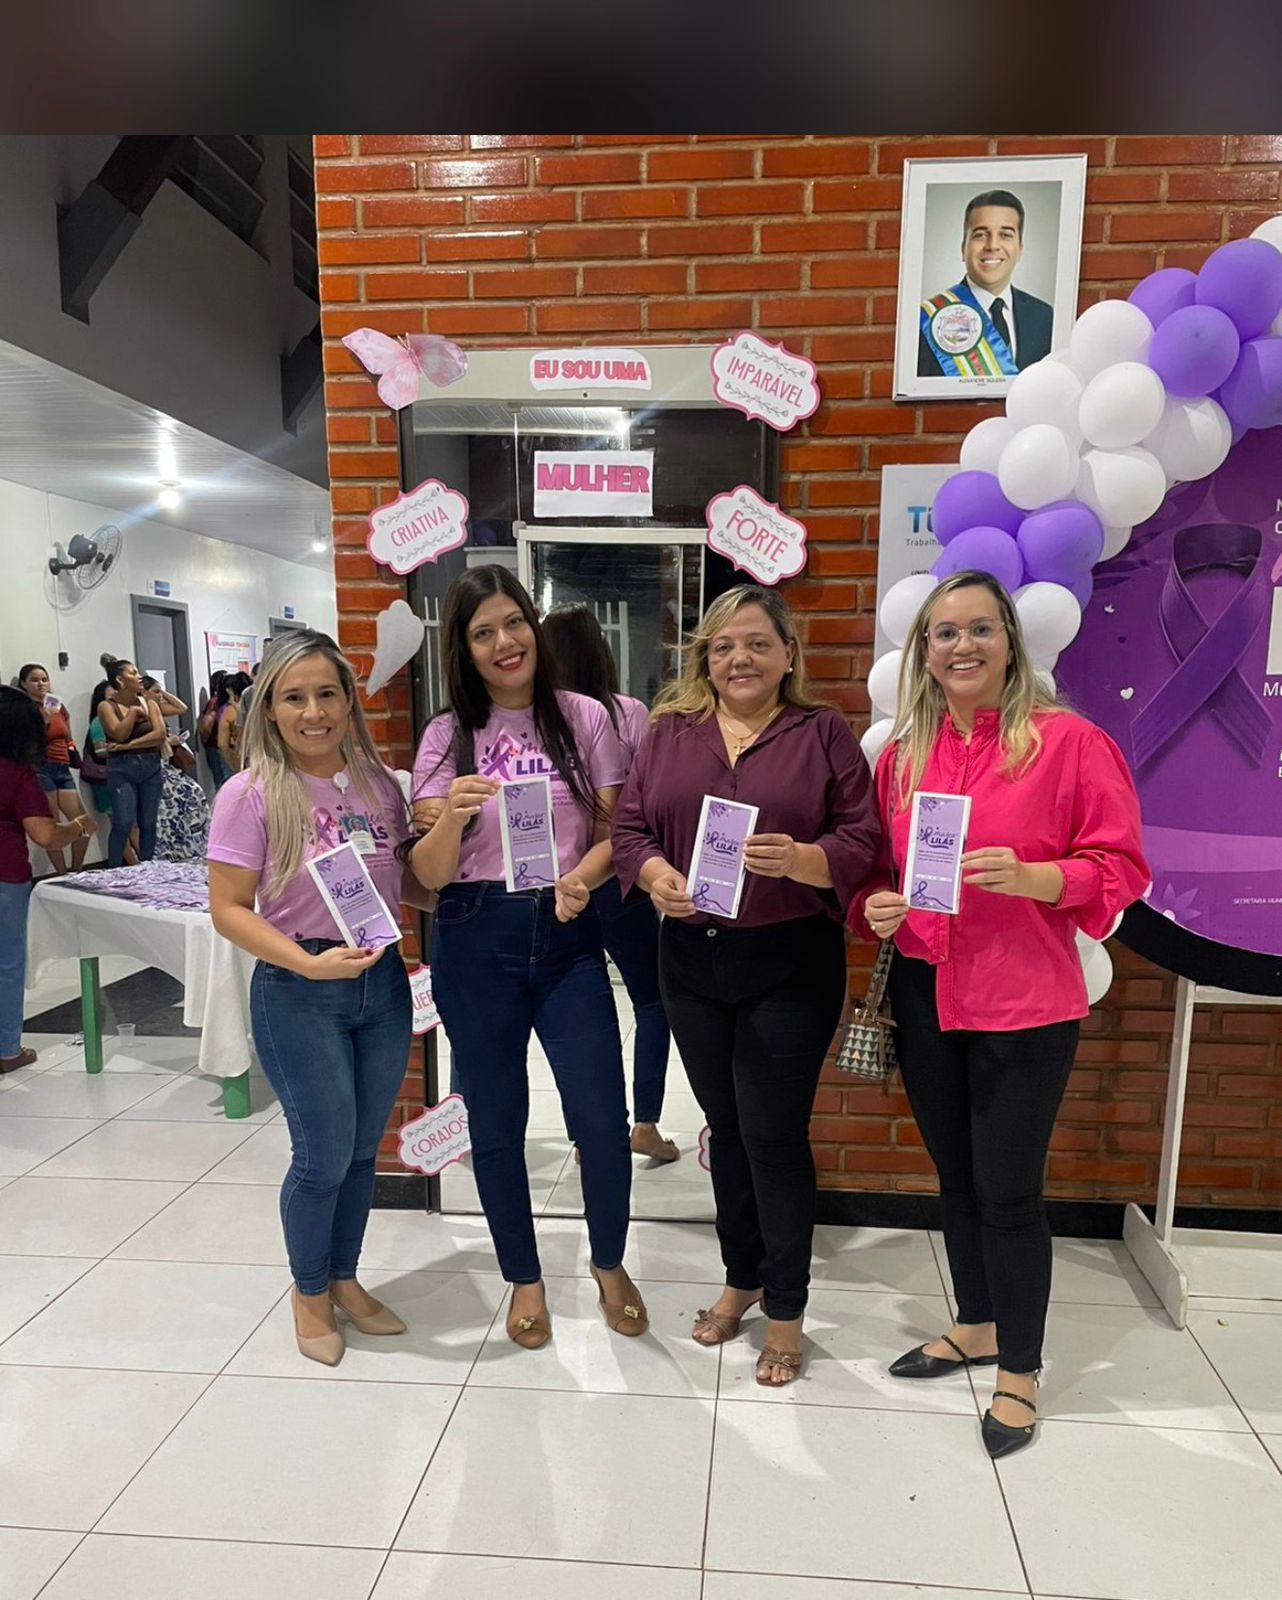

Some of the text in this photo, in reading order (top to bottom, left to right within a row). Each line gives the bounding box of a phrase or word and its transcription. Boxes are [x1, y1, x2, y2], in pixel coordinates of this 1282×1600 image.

[534, 359, 648, 381] EU SOU UMA
[727, 356, 804, 408] IMPARÁVEL
[537, 463, 650, 493] MULHER
[391, 506, 450, 547] CRIATIVA
[726, 509, 788, 563] FORTE
